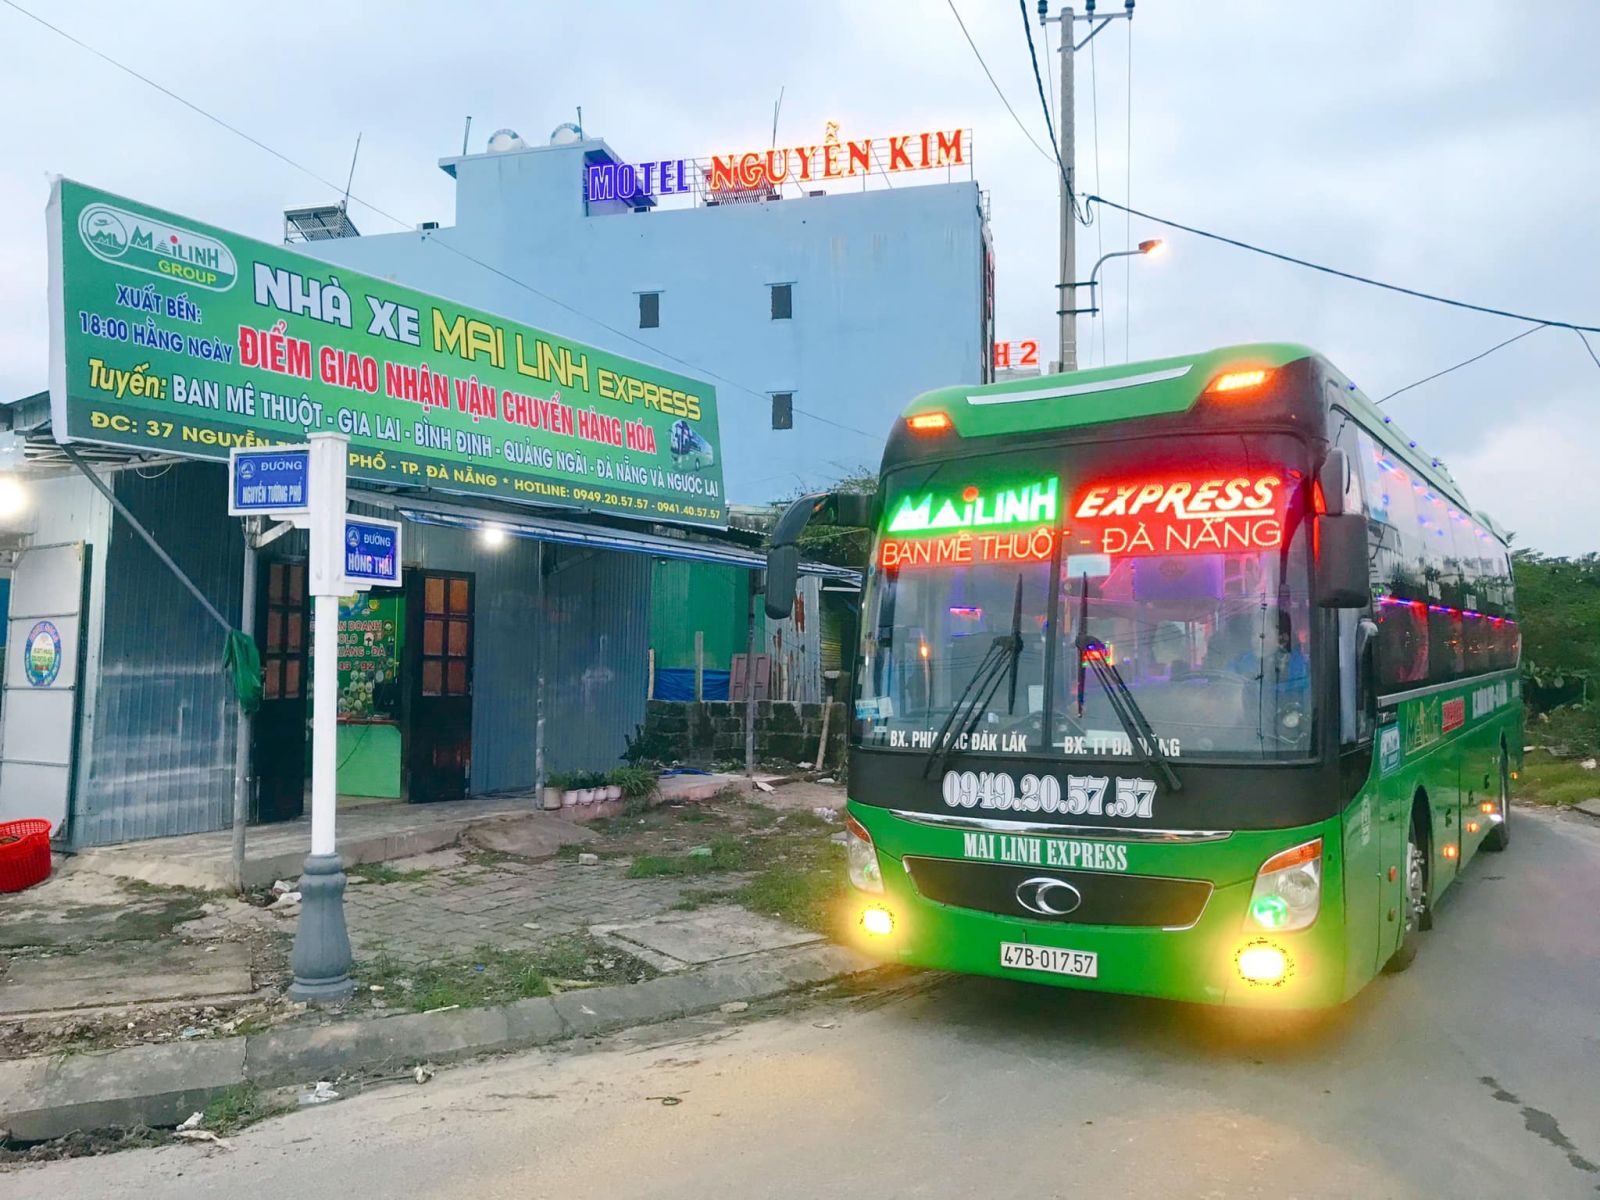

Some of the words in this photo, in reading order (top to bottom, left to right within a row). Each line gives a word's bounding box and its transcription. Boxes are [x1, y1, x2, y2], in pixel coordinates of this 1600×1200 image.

[588, 158, 690, 201] MOTEL
[710, 120, 872, 190] NGUYỄN
[889, 128, 964, 172] KIM
[158, 259, 217, 285] GROUP
[116, 283, 162, 315] XUẤT
[166, 292, 202, 324] BẾN:
[79, 311, 128, 342] 18:00
[132, 316, 184, 353] HẰNG
[188, 336, 233, 364] NGÀY
[252, 261, 353, 329] NHÀ
[365, 295, 421, 347] XE
[432, 308, 505, 369] MAI
[515, 333, 590, 392] LINH
[598, 368, 701, 421] EXPRESS
[1019, 339, 1037, 364] 2
[238, 319, 312, 380] ĐIỂM
[319, 346, 378, 395] GIAO
[385, 360, 449, 412] NHẬN
[455, 375, 497, 423] VẬN
[503, 391, 574, 438] CHUYỂN
[578, 406, 623, 449] HÀNG
[626, 417, 657, 454] HÓA
[88, 358, 168, 400] Tuyến:
[172, 374, 220, 410] BAN
[226, 381, 256, 417] MÊ
[260, 393, 323, 433] THUỘT
[337, 408, 371, 441] GIA
[376, 413, 401, 442] LAI
[414, 416, 452, 451] BÌNH
[455, 429, 493, 461] ĐỊNH
[503, 435, 553, 469] QUẢNG
[596, 456, 614, 479] ĐÀ
[616, 455, 648, 485] NẴNG
[650, 467, 665, 488] VÀ
[667, 473, 703, 498] NGƯỢC
[704, 479, 719, 501] LẠI
[91, 411, 137, 434] ĐC:
[146, 420, 173, 438] 37
[182, 427, 269, 447] NGUYỄN
[349, 451, 387, 470] PHỔ
[400, 460, 421, 476] TP.
[426, 463, 449, 480] ĐÀ
[453, 466, 497, 487] NẴNG
[514, 478, 570, 498] HOTLINE:
[573, 488, 648, 510] 0949.20.57.57
[657, 501, 721, 520] 0941.40.57.57
[261, 459, 303, 471] ĐƯỜNG
[1075, 476, 1281, 520] EXPRESS
[363, 531, 391, 547] ĐƯỜNG
[882, 540, 932, 566] BAN
[936, 531, 973, 563] MÊ
[1102, 521, 1154, 554] ĐÀ
[1166, 517, 1281, 551] NẴNG
[890, 730, 909, 748] BX.
[971, 730, 998, 752] ĐĂK
[1001, 730, 1028, 753] LĂK
[1064, 736, 1088, 754] BX.
[942, 770, 1158, 818] 0949.20.57.57
[963, 833, 995, 860] MAI
[1000, 835, 1041, 864] LINH
[1047, 840, 1128, 871] EXPRESS
[1003, 948, 1094, 975] 47B-017.57
